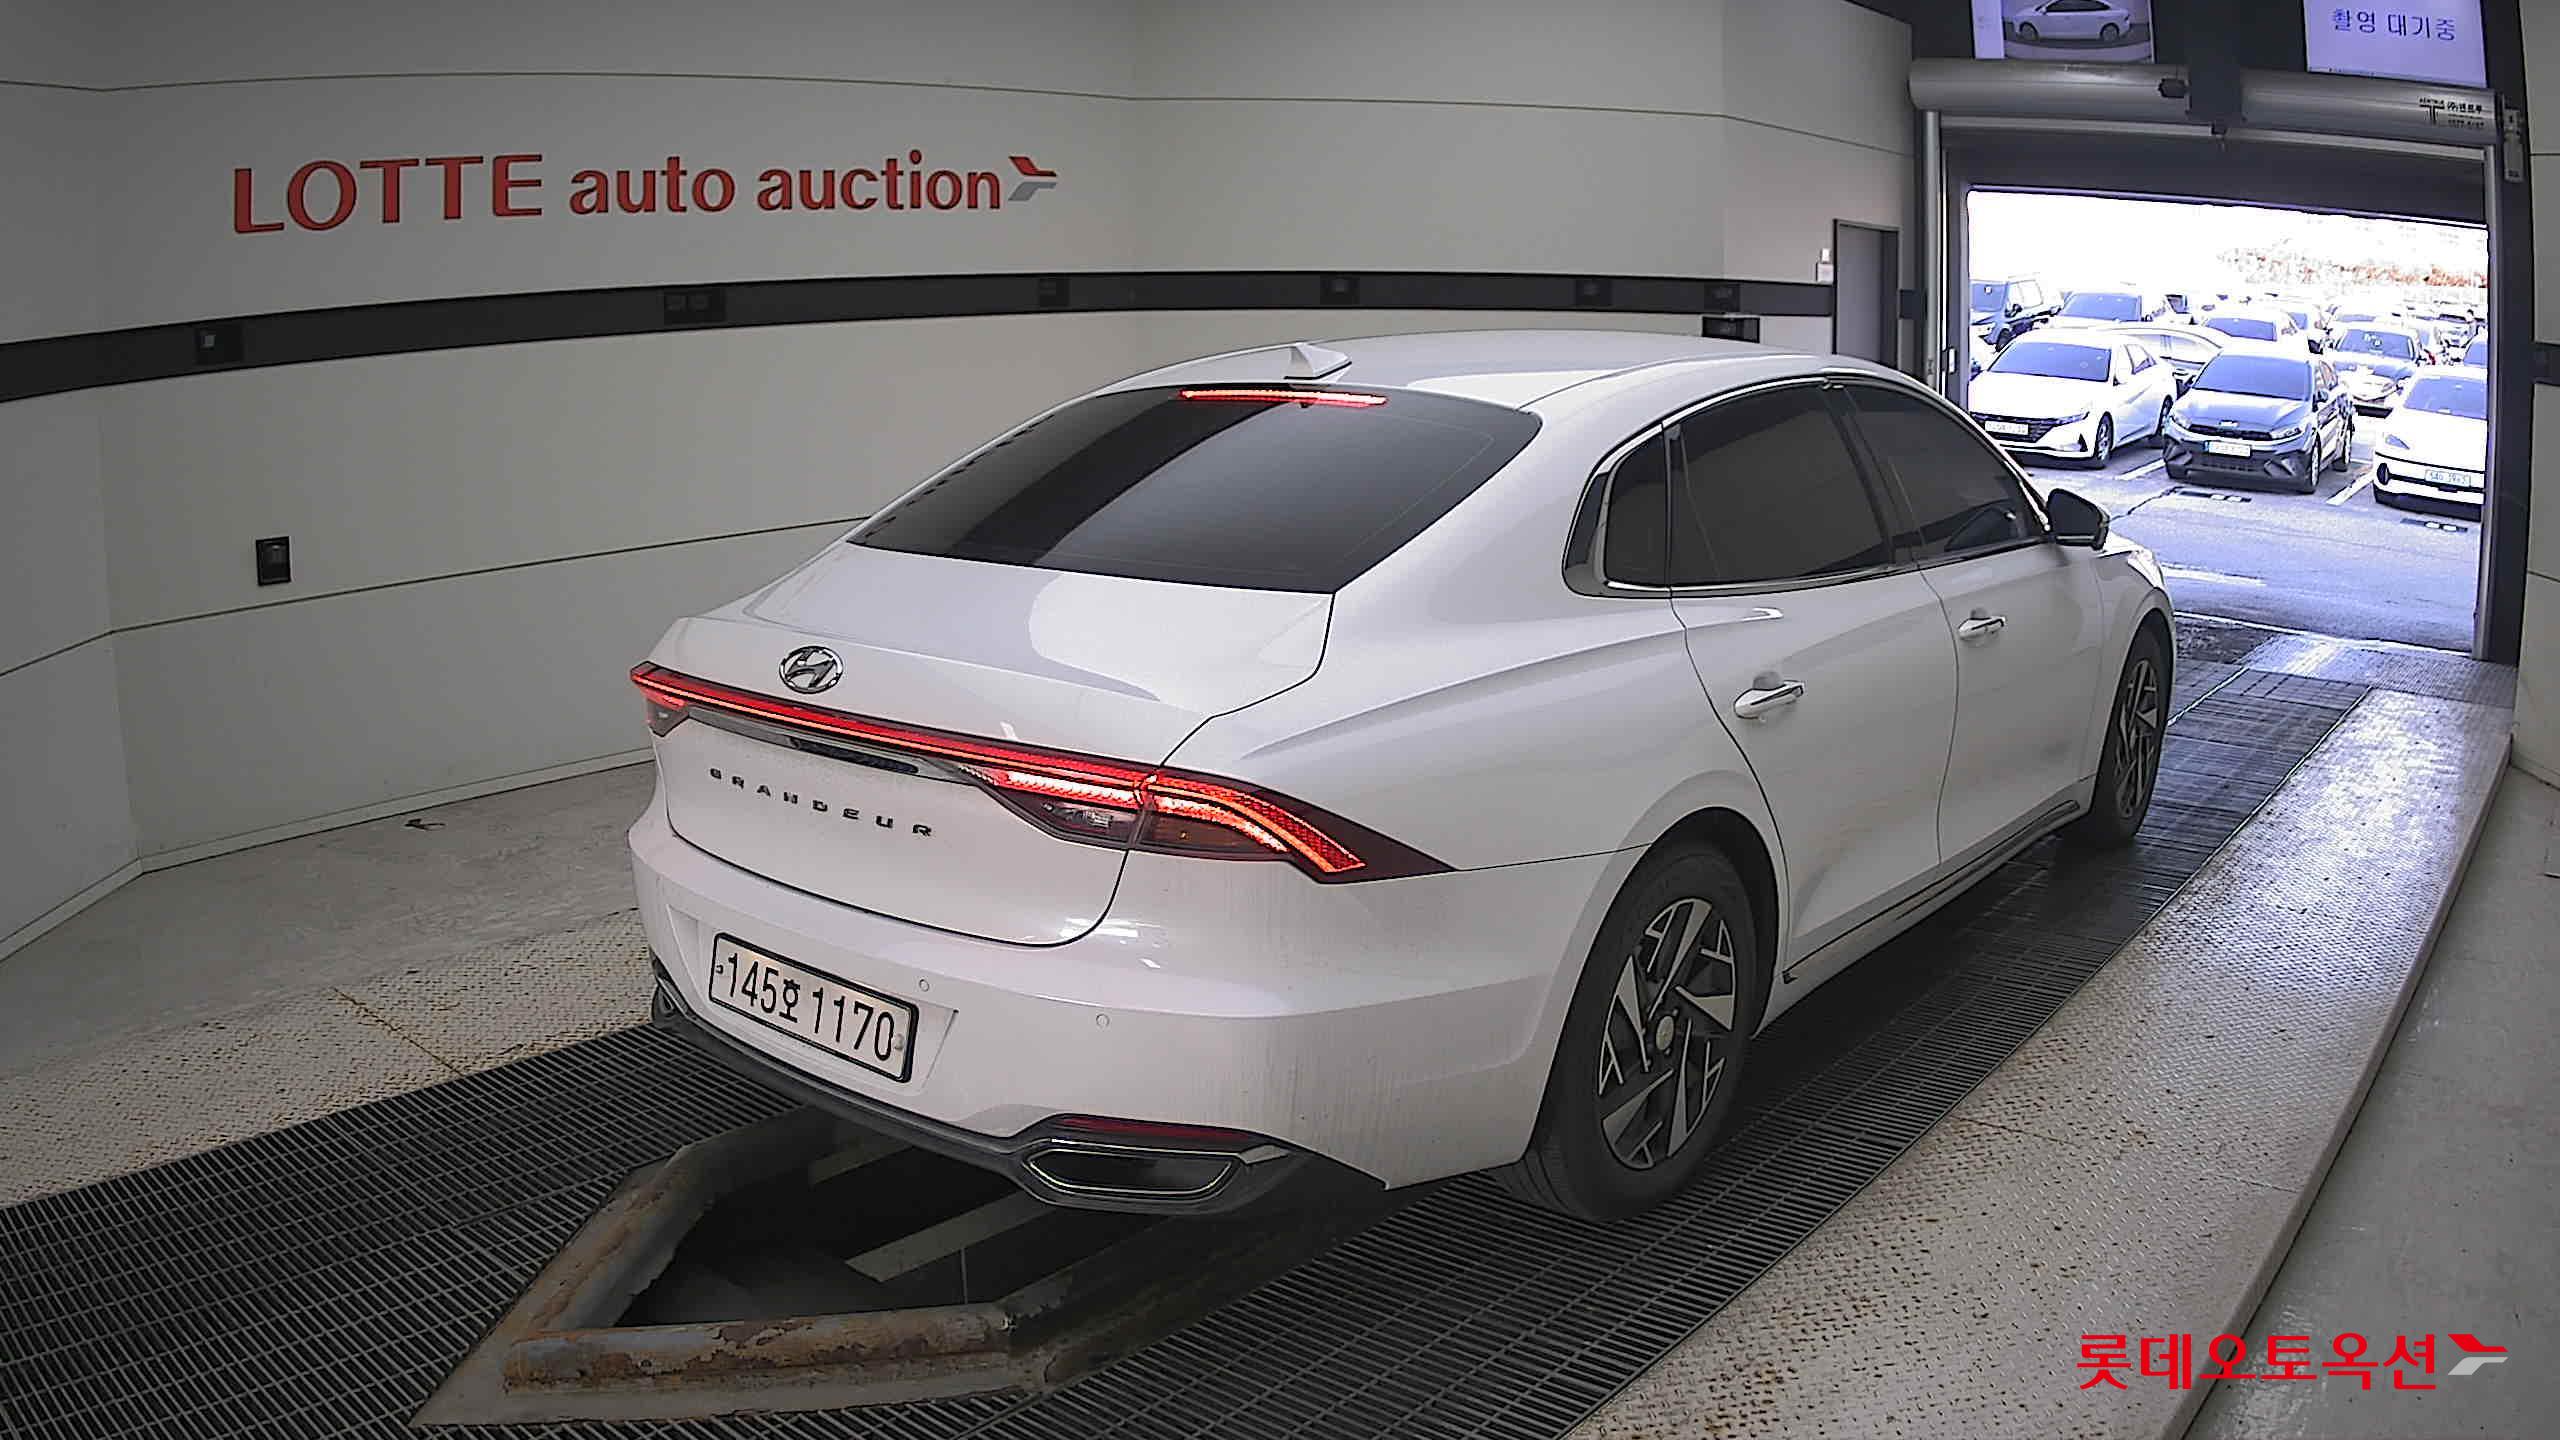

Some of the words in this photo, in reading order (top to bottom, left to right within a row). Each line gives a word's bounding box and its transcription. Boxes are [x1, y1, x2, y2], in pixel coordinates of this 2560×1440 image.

[2333, 8, 2377, 35] 촬영
[2387, 13, 2456, 41] 대기중
[234, 154, 541, 234] LOTTE
[569, 157, 736, 215] auto
[756, 151, 1002, 211] auction
[710, 767, 933, 836] GRANDEUR
[728, 952, 801, 1023] 145호
[812, 987, 895, 1061] 1170
